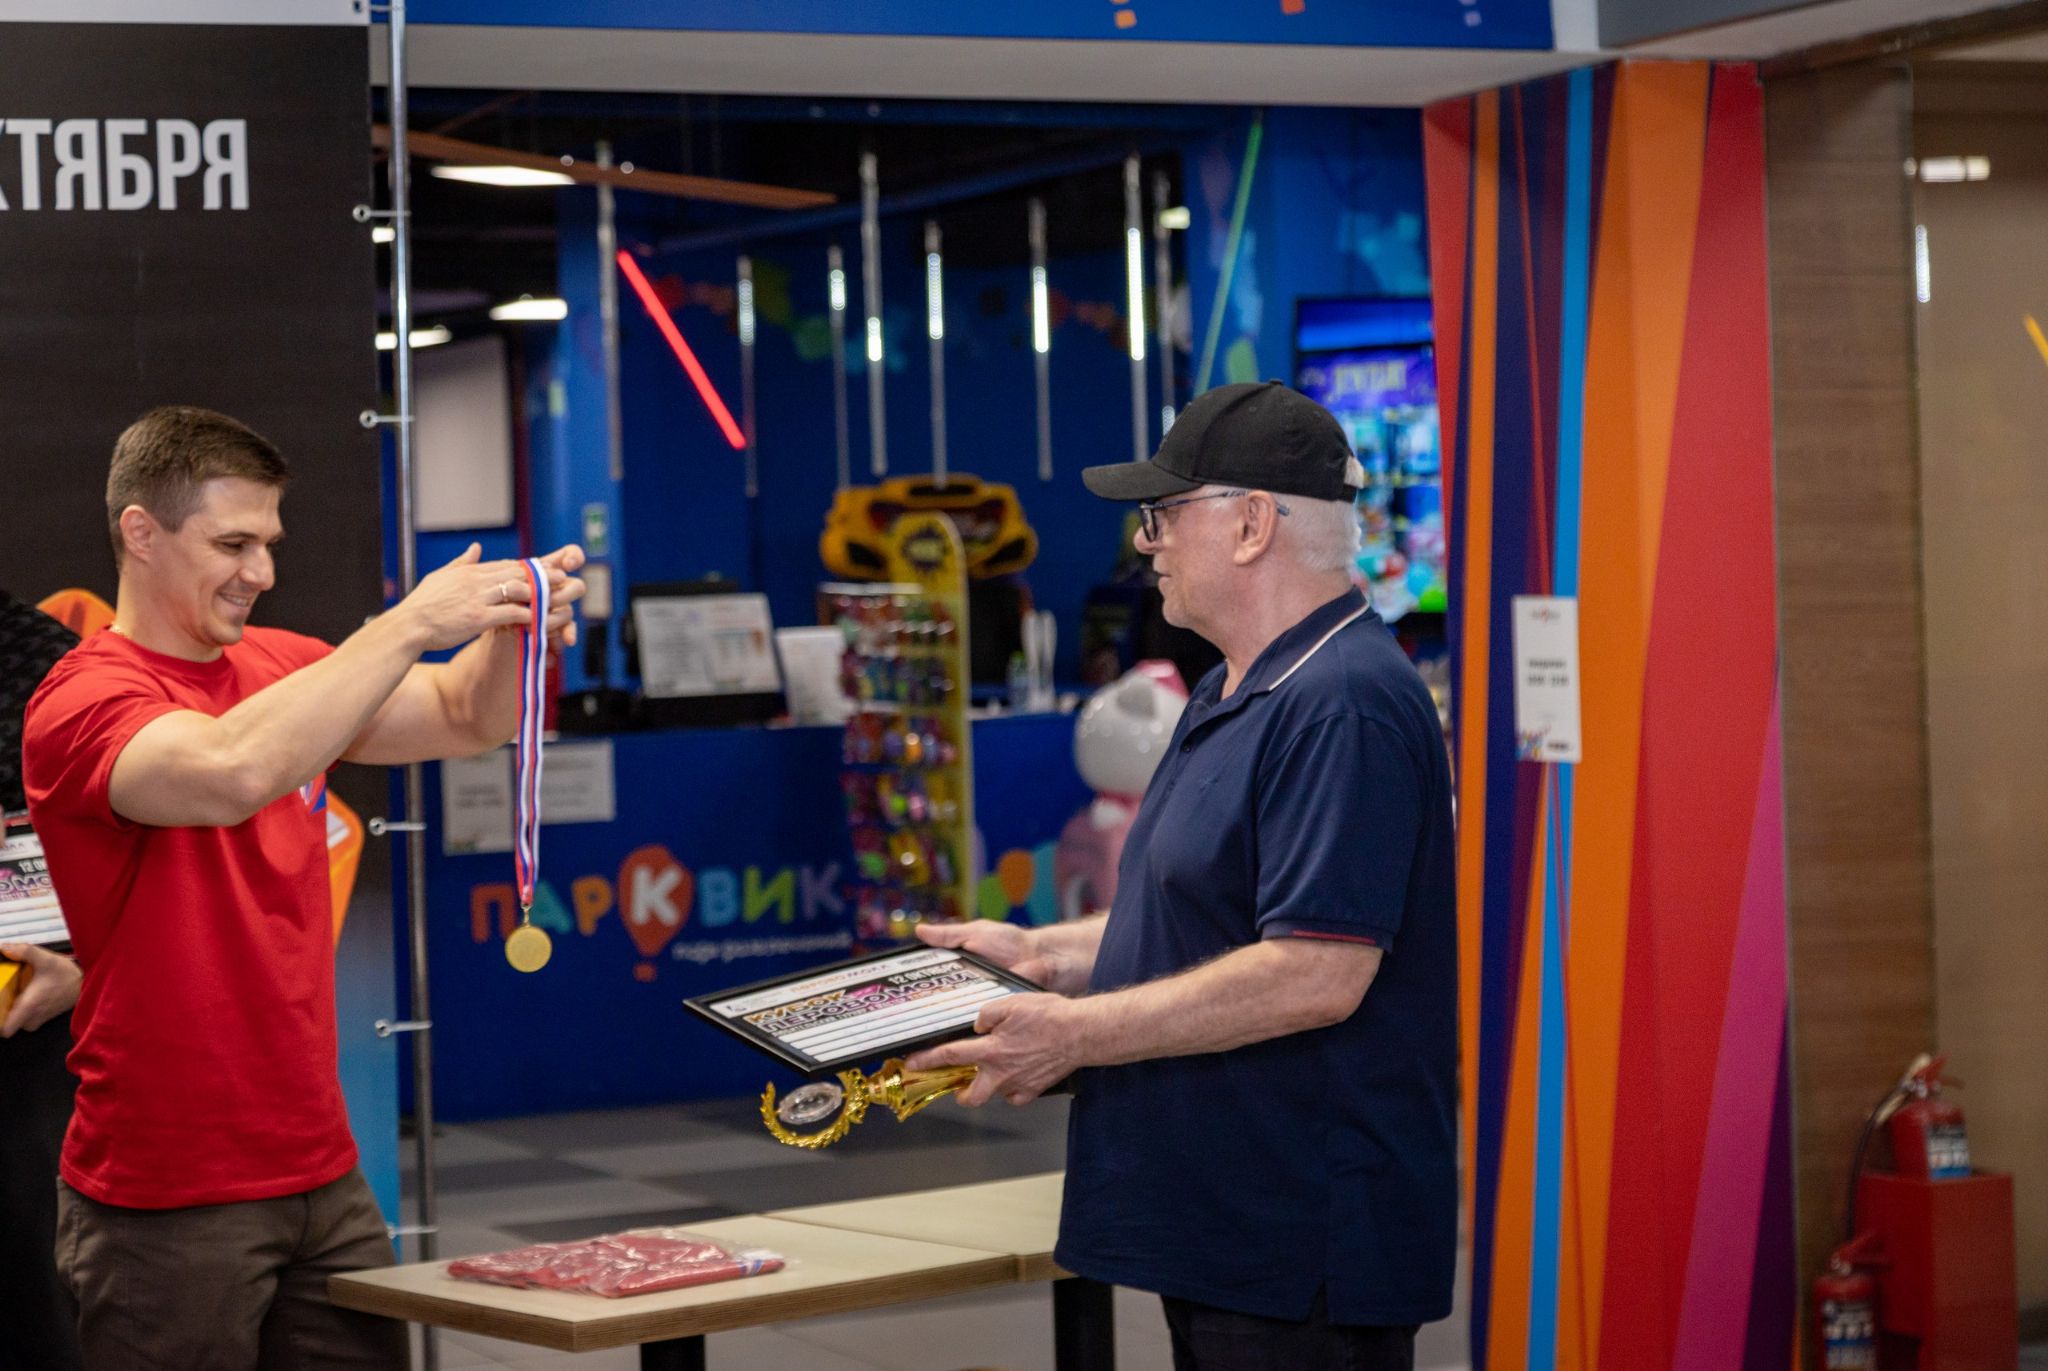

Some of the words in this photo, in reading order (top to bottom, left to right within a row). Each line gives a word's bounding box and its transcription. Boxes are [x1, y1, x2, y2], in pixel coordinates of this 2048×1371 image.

[0, 119, 250, 211] ТЯБРЯ
[758, 986, 890, 1034] ПЕРОВО
[884, 969, 980, 1001] МОЛЛ
[888, 974, 908, 985] 12
[743, 989, 846, 1026] КУБОК
